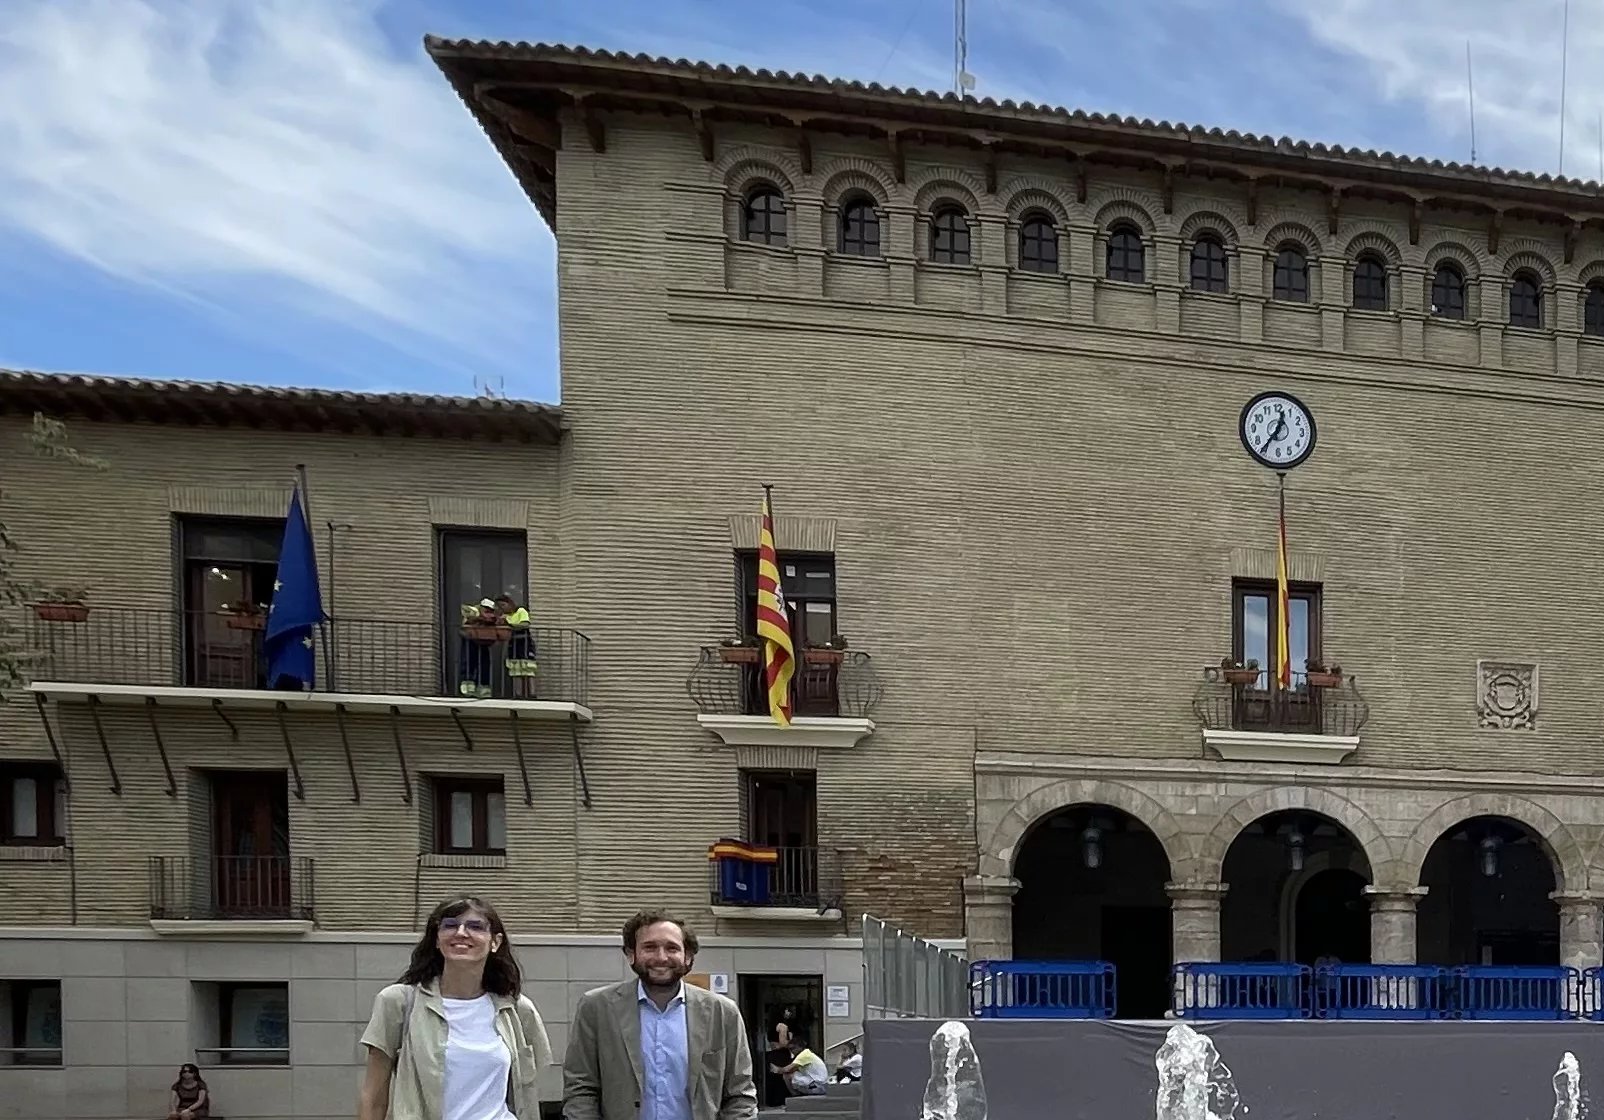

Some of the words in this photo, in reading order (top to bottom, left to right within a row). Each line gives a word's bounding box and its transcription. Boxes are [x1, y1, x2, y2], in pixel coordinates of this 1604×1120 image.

[1263, 405, 1271, 416] 11
[1273, 404, 1283, 413] 12
[1288, 408, 1292, 418] 1
[1254, 414, 1264, 424] 10
[1295, 416, 1301, 426] 2
[1251, 423, 1257, 433] 9
[1299, 428, 1305, 438] 3
[1255, 435, 1261, 445] 8
[1295, 439, 1300, 448] 4
[1275, 447, 1281, 457] 6
[1286, 446, 1292, 456] 5
